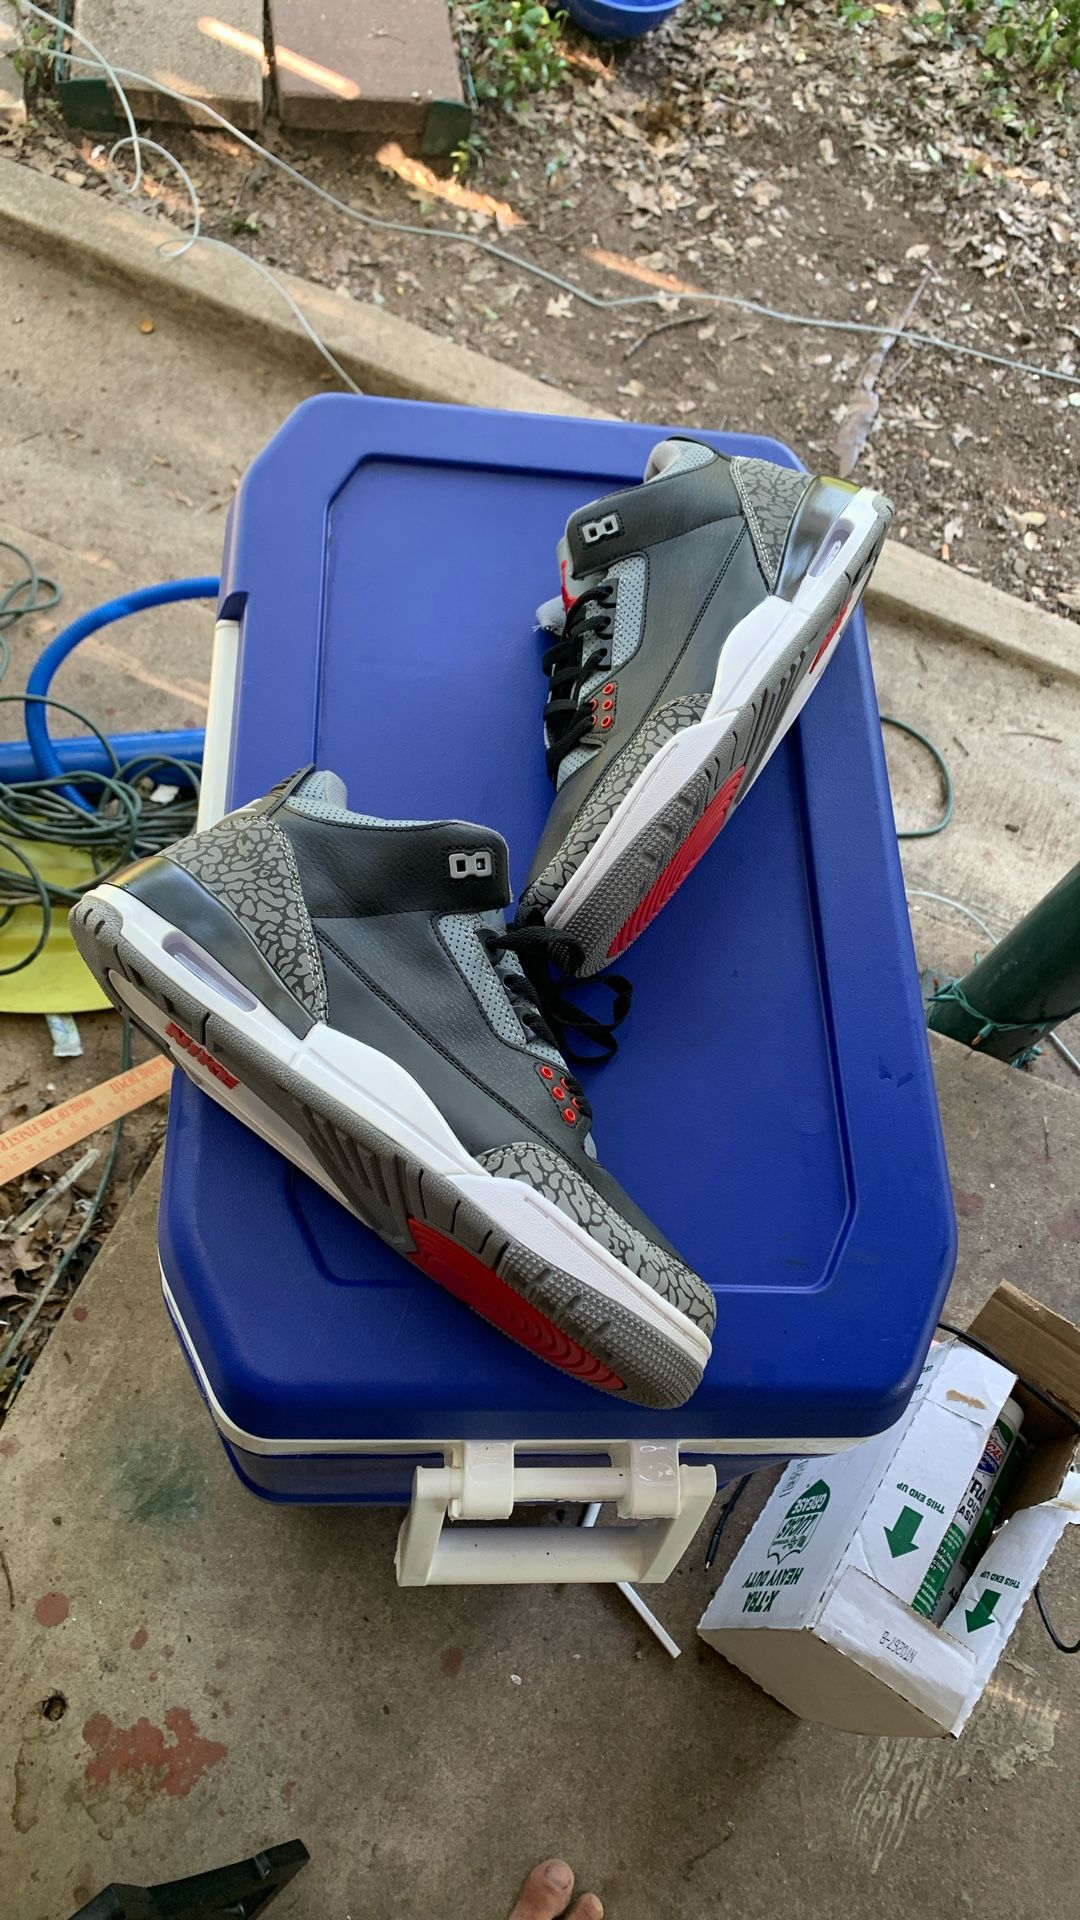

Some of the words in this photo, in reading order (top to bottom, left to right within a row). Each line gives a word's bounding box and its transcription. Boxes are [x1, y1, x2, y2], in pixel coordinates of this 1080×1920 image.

[165, 1020, 240, 1090] NIKE
[7, 1123, 40, 1147] FINEST
[896, 1482, 909, 1493] UP
[909, 1488, 927, 1503] END
[792, 1492, 827, 1514] GREASE
[926, 1497, 945, 1515] THIS
[776, 1514, 819, 1539] LUCAS
[742, 1570, 771, 1589] DUTY
[766, 1567, 804, 1587] HEAVY
[980, 1570, 990, 1579] UP
[990, 1573, 1005, 1584] END
[1003, 1577, 1020, 1589] THIS
